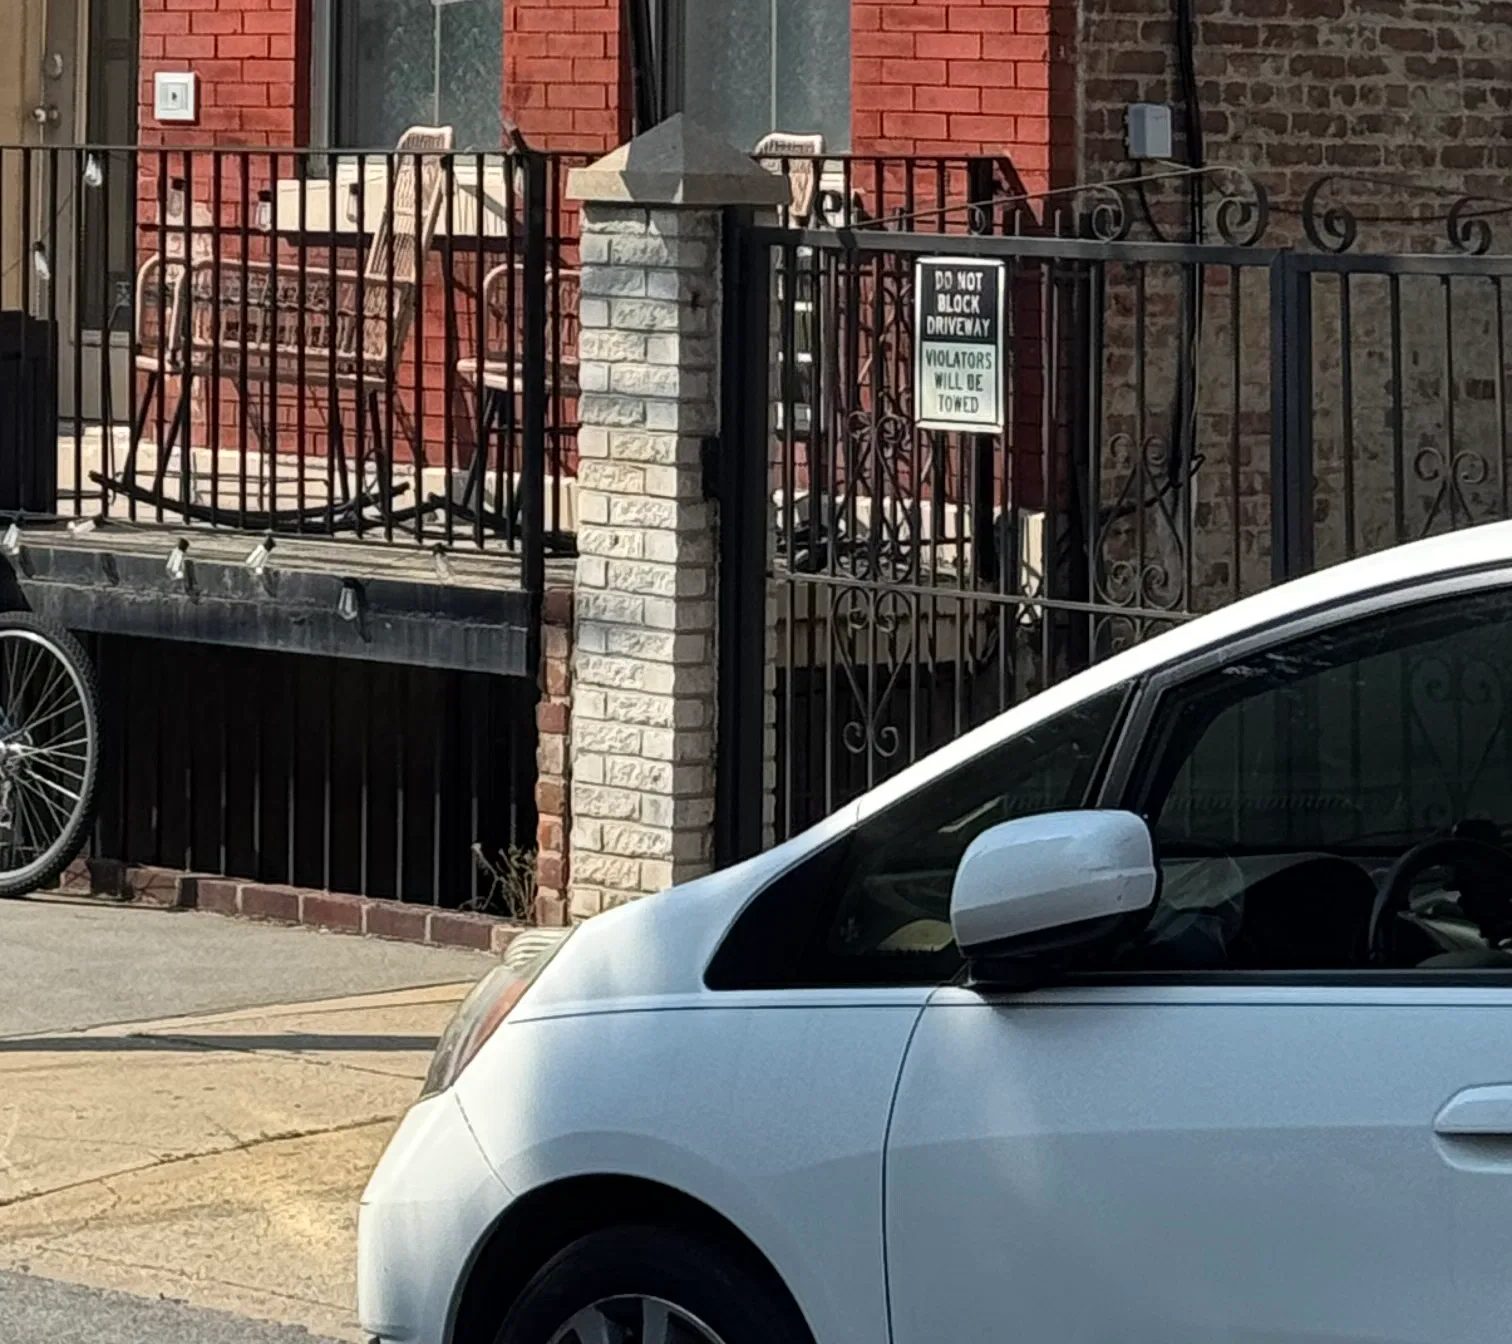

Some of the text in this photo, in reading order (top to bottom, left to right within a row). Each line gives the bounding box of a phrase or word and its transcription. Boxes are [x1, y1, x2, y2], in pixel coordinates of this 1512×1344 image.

[934, 270, 984, 292] DO NOT
[937, 293, 981, 314] BLOCK
[926, 315, 991, 337] DRIVEWAY
[925, 349, 992, 370] VIOLATORS
[934, 371, 984, 392] WILL BE
[938, 394, 980, 414] TOWED
